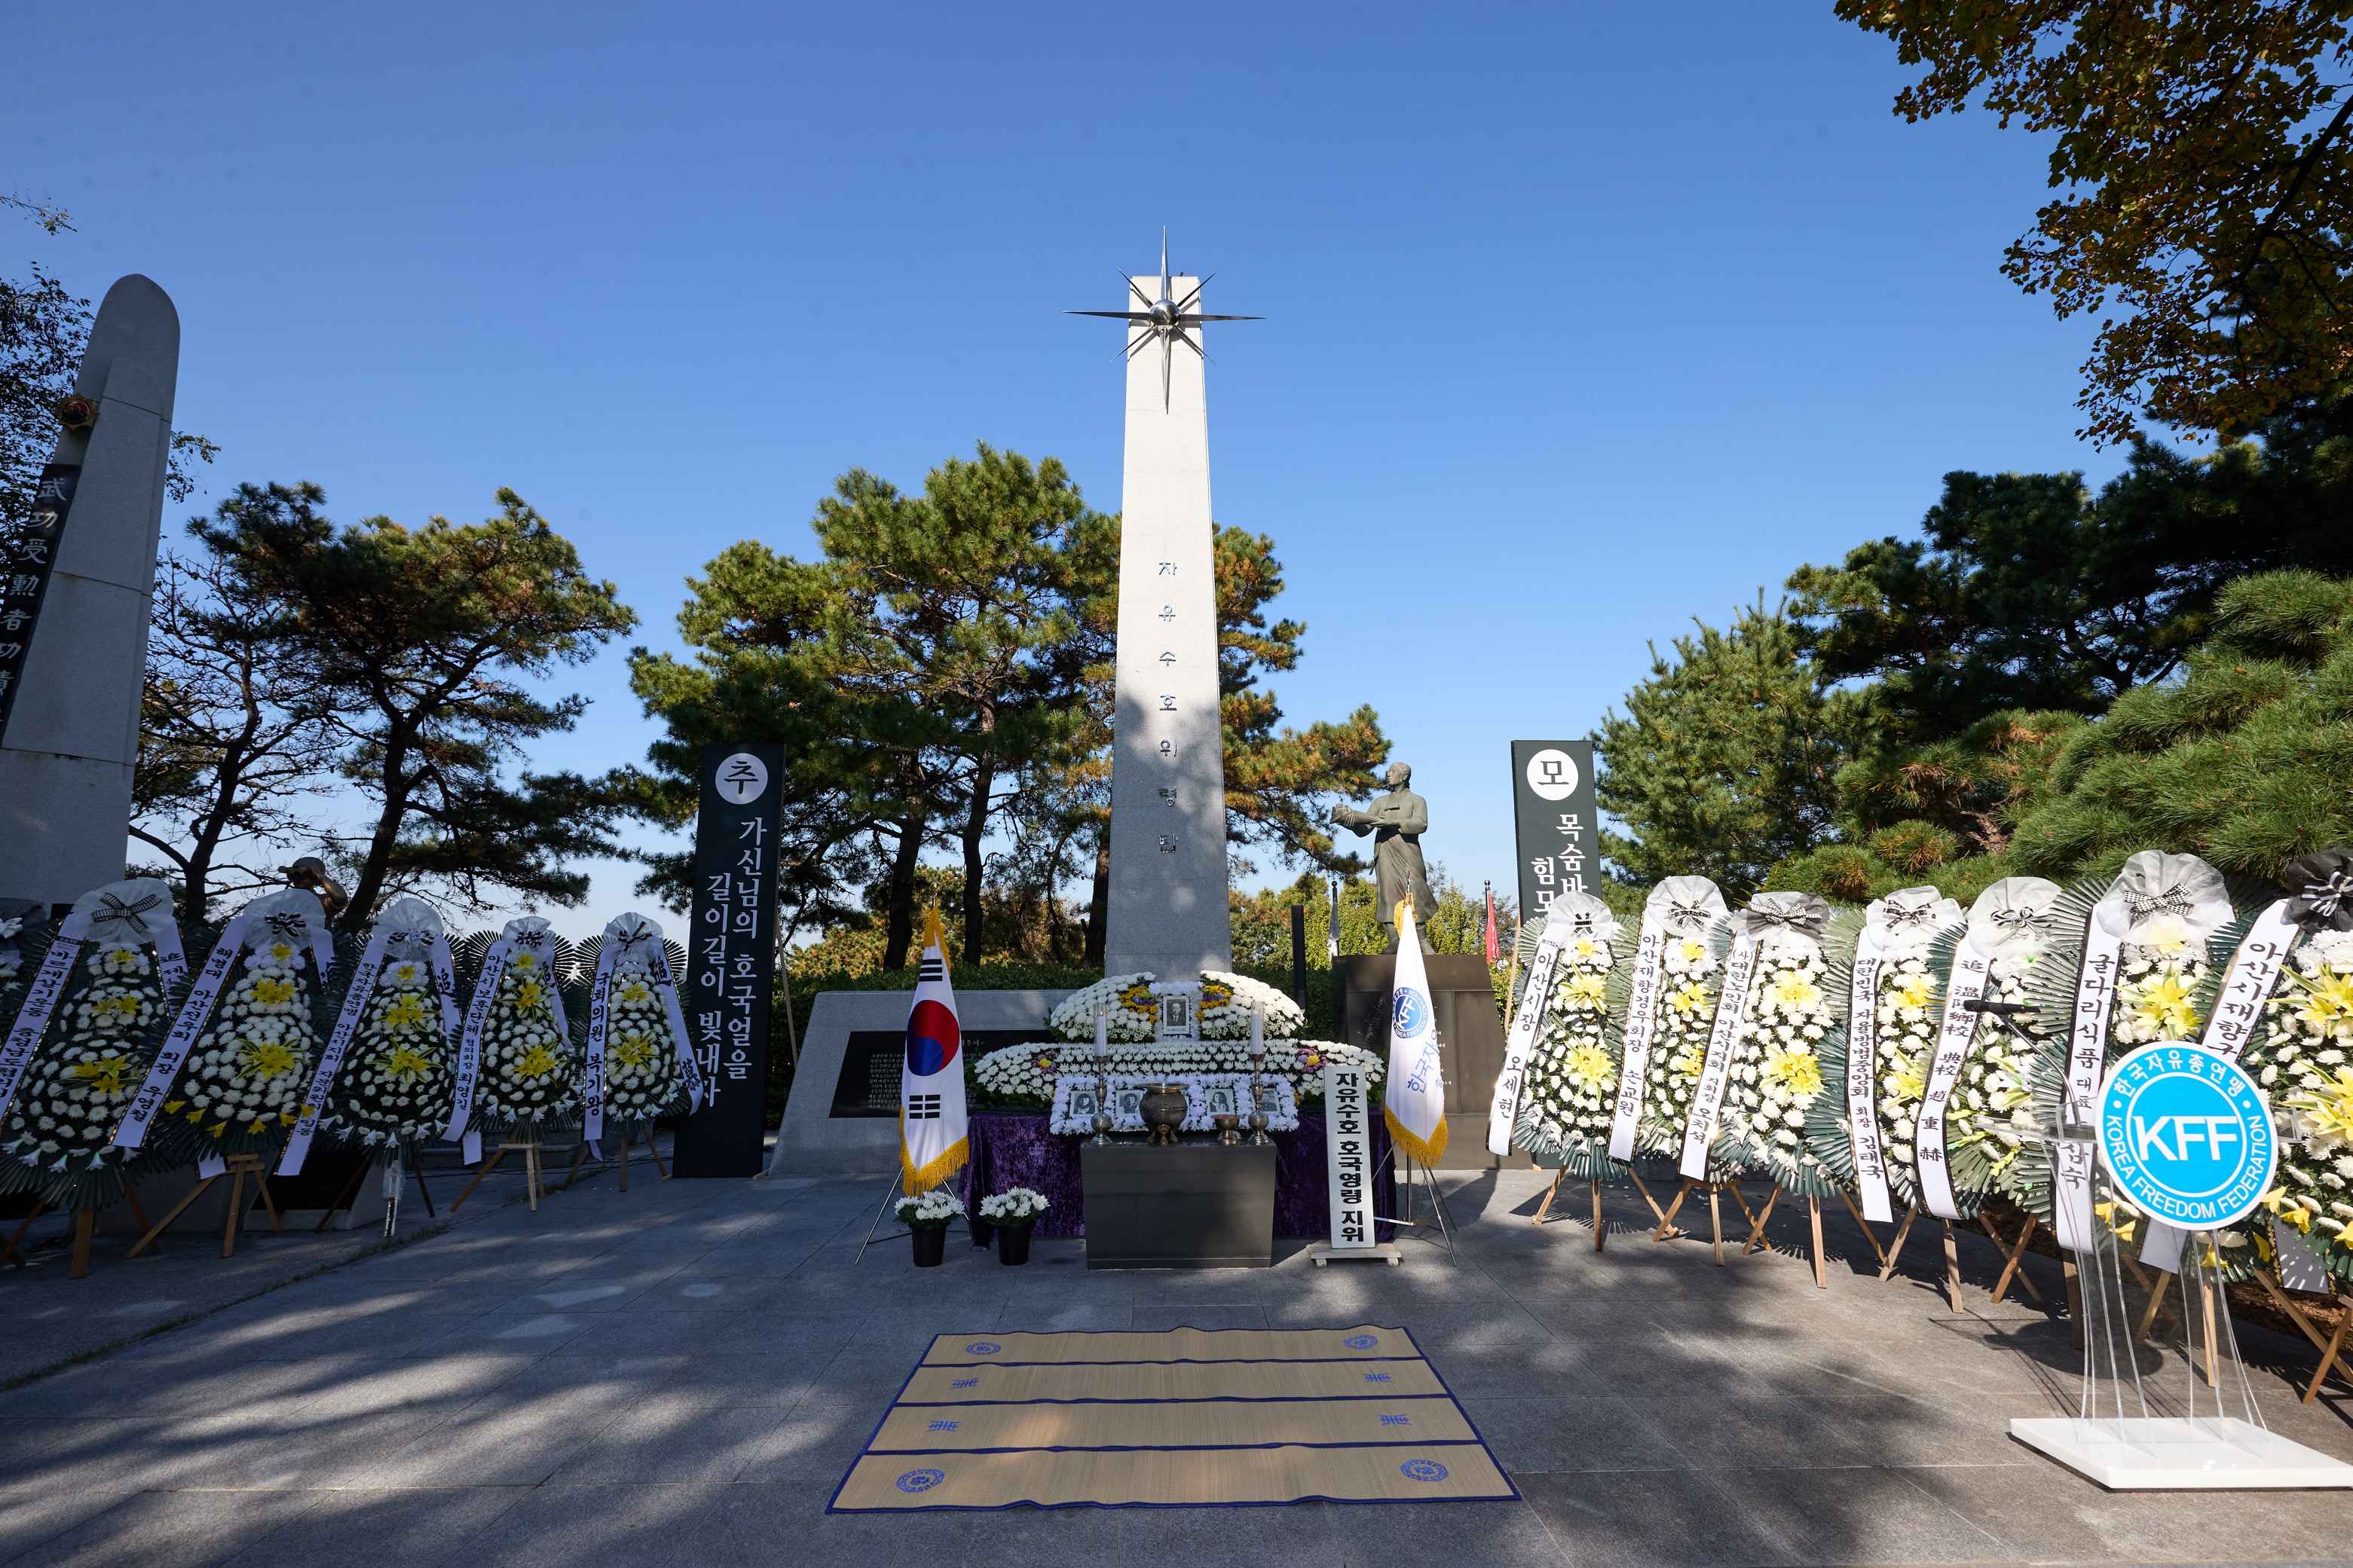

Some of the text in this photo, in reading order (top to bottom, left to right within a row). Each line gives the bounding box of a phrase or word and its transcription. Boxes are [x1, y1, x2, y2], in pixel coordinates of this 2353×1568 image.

[724, 760, 758, 794] 추
[1538, 761, 1569, 785] 모
[700, 873, 732, 998] 길이길이
[724, 817, 767, 1080] 가신님의 호국얼을
[479, 955, 503, 987] 아산시
[1519, 953, 1552, 1031] 아산시장
[1626, 934, 1659, 1053] 아산재향경우회장
[1960, 960, 1985, 974] 追
[466, 990, 491, 1035] 보훈단체
[2075, 954, 2115, 1068] 굴다리식품
[155, 1052, 181, 1074] 회장
[588, 972, 610, 1116] 국회의원 복기왕
[1708, 1019, 1736, 1072] 아산시지회
[1850, 959, 1883, 1179] 대한민국 자율방범중앙회 회장 김태국
[1500, 1056, 1521, 1119] 오세현
[1702, 1077, 1718, 1103] 지회장
[2113, 1050, 2245, 1098] 한국자유총연맹
[1336, 1073, 1364, 1242] 자유수호 호국영령 지위
[2107, 1114, 2267, 1219] KOREA FREEDOM FEDERATION
[2132, 1115, 2238, 1161] KFF
